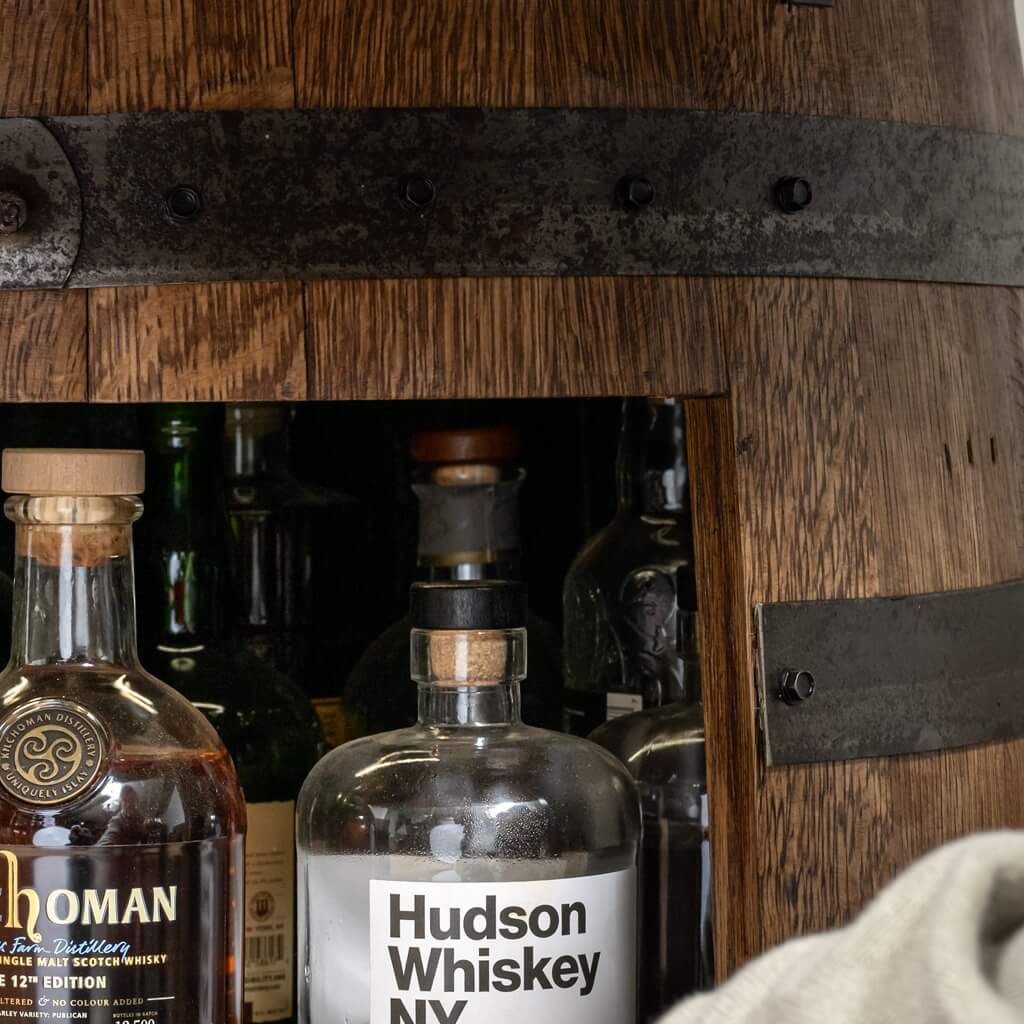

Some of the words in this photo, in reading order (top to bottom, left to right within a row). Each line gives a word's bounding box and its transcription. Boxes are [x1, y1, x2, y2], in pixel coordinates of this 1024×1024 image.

[0, 713, 51, 760] KILCHOMAN
[56, 713, 96, 758] DISTILLERY
[6, 773, 58, 798] UNIQUELY
[61, 770, 89, 794] ISLAY
[389, 893, 587, 940] Hudson
[37, 957, 69, 967] MALT
[73, 957, 120, 967] SCOTCH
[124, 954, 168, 966] WHISKY
[53, 938, 131, 964] Distillery
[43, 976, 107, 989] EDITION
[388, 945, 601, 996] Whiskey
[52, 999, 67, 1007] NO
[113, 998, 144, 1006] ADDED
